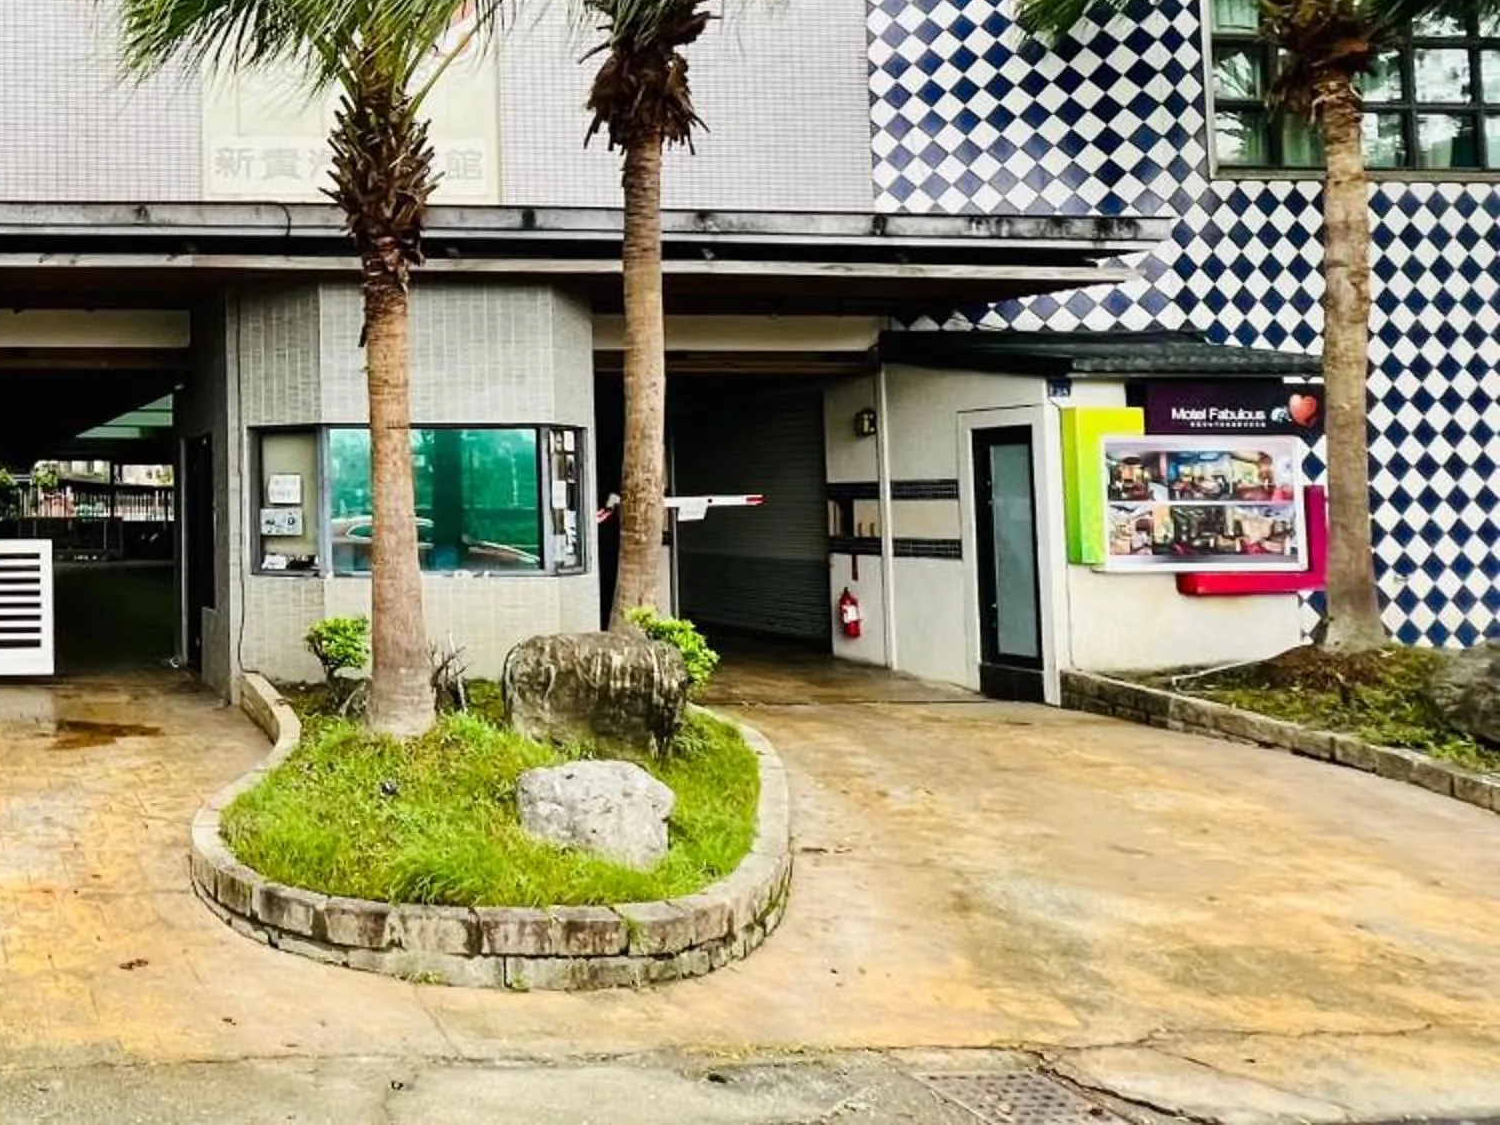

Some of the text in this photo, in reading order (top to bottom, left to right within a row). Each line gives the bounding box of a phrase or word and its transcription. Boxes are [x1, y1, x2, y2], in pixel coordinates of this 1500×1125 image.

[213, 146, 484, 181] 新貴館
[1171, 406, 1266, 420] Motel Fabulous
